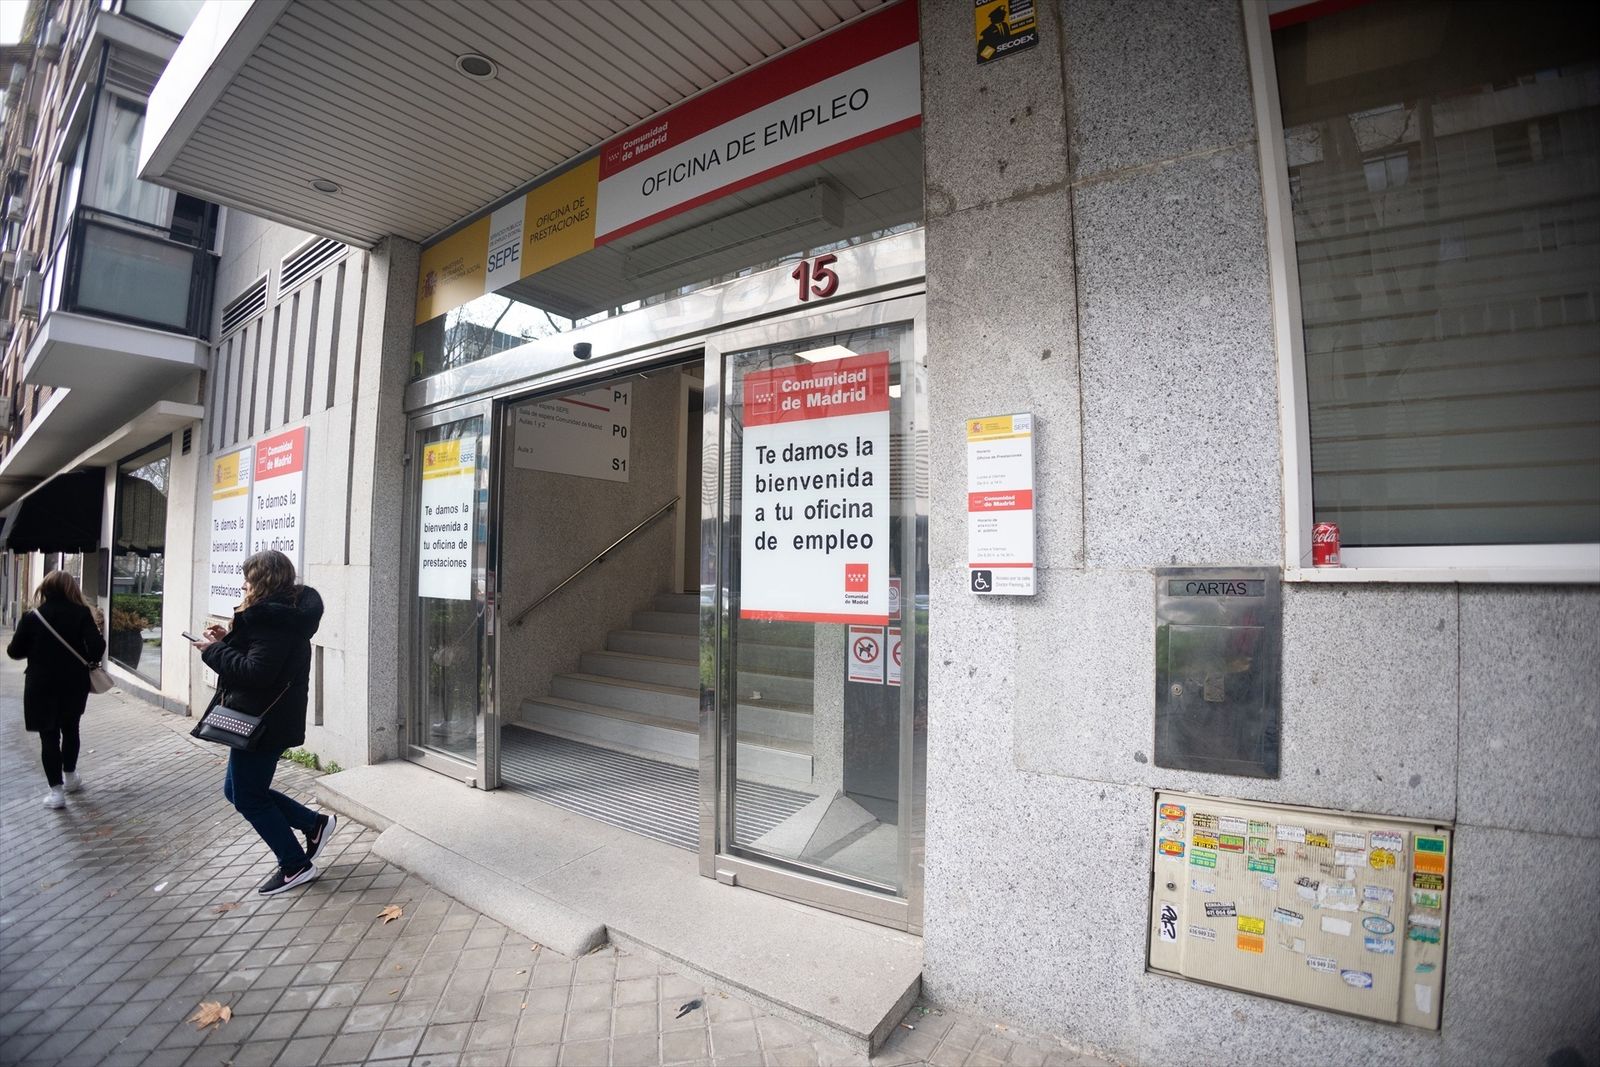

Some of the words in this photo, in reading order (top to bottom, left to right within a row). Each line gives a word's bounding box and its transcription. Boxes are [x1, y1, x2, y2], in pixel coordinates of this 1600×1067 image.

[997, 34, 1034, 52] SECOEX
[622, 121, 669, 151] Comunidad
[642, 148, 722, 196] OFICINA
[726, 132, 757, 162] DE
[764, 88, 870, 146] EMPLEO
[621, 150, 633, 162] de
[634, 132, 668, 156] Madrid
[536, 202, 571, 228] OFICINA
[572, 196, 585, 212] DE
[529, 208, 590, 244] PRESTACIONES
[488, 242, 520, 272] SEPE
[792, 254, 839, 302] 15
[781, 368, 867, 393] Comunidad
[614, 390, 628, 405] P1
[781, 394, 801, 412] de
[806, 386, 866, 408] Madrid
[612, 424, 627, 438] P0
[268, 440, 293, 456] Comunidad
[756, 445, 776, 465] Te
[782, 441, 848, 463] damos
[856, 436, 873, 457] la
[267, 458, 273, 470] de
[274, 453, 292, 468] Madrid
[612, 458, 626, 471] S1
[755, 467, 873, 493] bienvenida
[257, 496, 264, 510] Te
[265, 492, 288, 508] damos
[289, 490, 296, 505] la
[425, 505, 432, 516] Te
[435, 504, 458, 515] damos
[462, 503, 469, 513] la
[755, 506, 765, 522] a
[774, 502, 793, 521] tu
[804, 499, 873, 520] oficina
[214, 519, 219, 531] Te
[220, 518, 237, 531] damos
[239, 517, 244, 529] la
[256, 514, 295, 531] bienvenida
[424, 521, 461, 532] bienvenida
[463, 523, 468, 531] a
[755, 531, 778, 551] de
[793, 529, 874, 555] empleo
[1312, 526, 1336, 543] Cola
[212, 541, 238, 552] bienvenida
[239, 544, 243, 552] a
[254, 541, 259, 552] a
[261, 540, 268, 552] tu
[271, 538, 294, 552] oficina
[424, 541, 430, 550] tu
[432, 539, 456, 550] oficina
[458, 539, 467, 549] de
[212, 562, 216, 573] tu
[218, 562, 234, 574] oficina
[235, 562, 242, 575] de
[423, 557, 467, 569] prestaciones
[211, 583, 242, 598] prestaciones
[1186, 582, 1247, 596] CARTAS
